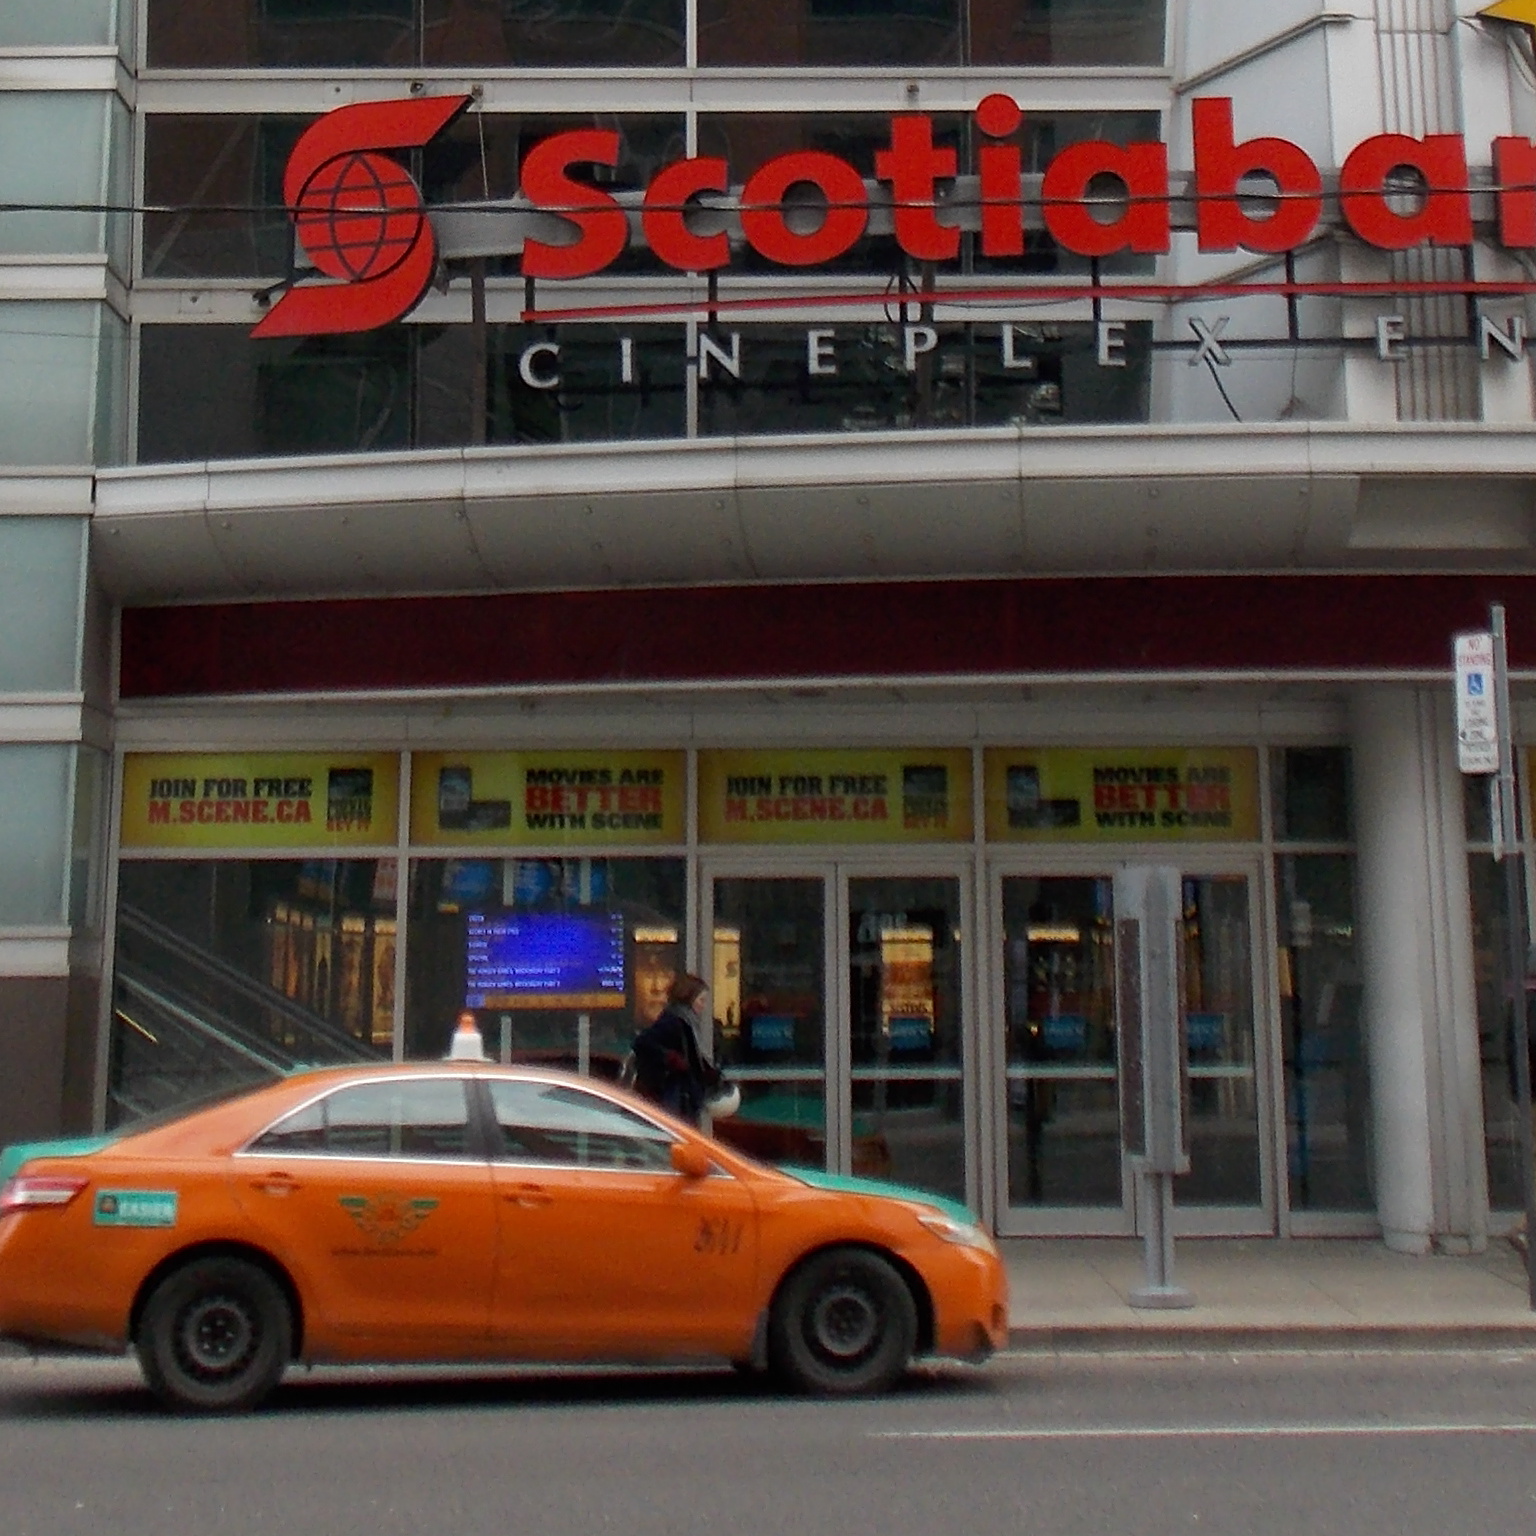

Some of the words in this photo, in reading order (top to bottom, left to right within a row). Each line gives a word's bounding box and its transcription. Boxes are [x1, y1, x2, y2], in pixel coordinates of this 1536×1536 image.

[518, 314, 1234, 390] CINEPLEX
[525, 769, 612, 785] MOVIES
[618, 768, 664, 785] ARE
[726, 776, 772, 797] JOIN
[779, 775, 822, 796] FOR
[828, 775, 888, 796] FREE
[1093, 767, 1179, 784] MOVIES
[150, 778, 196, 798] JOIN
[203, 778, 247, 798] FOR
[253, 777, 312, 798] FREE
[1093, 784, 1231, 812] BETTER
[525, 785, 663, 814] BETTER
[725, 797, 888, 822] M.SCENE.CA
[148, 800, 312, 824] M.SCENE.CA
[525, 814, 586, 831] WITH
[591, 813, 663, 830] SCENE
[1094, 812, 1156, 828] WITH
